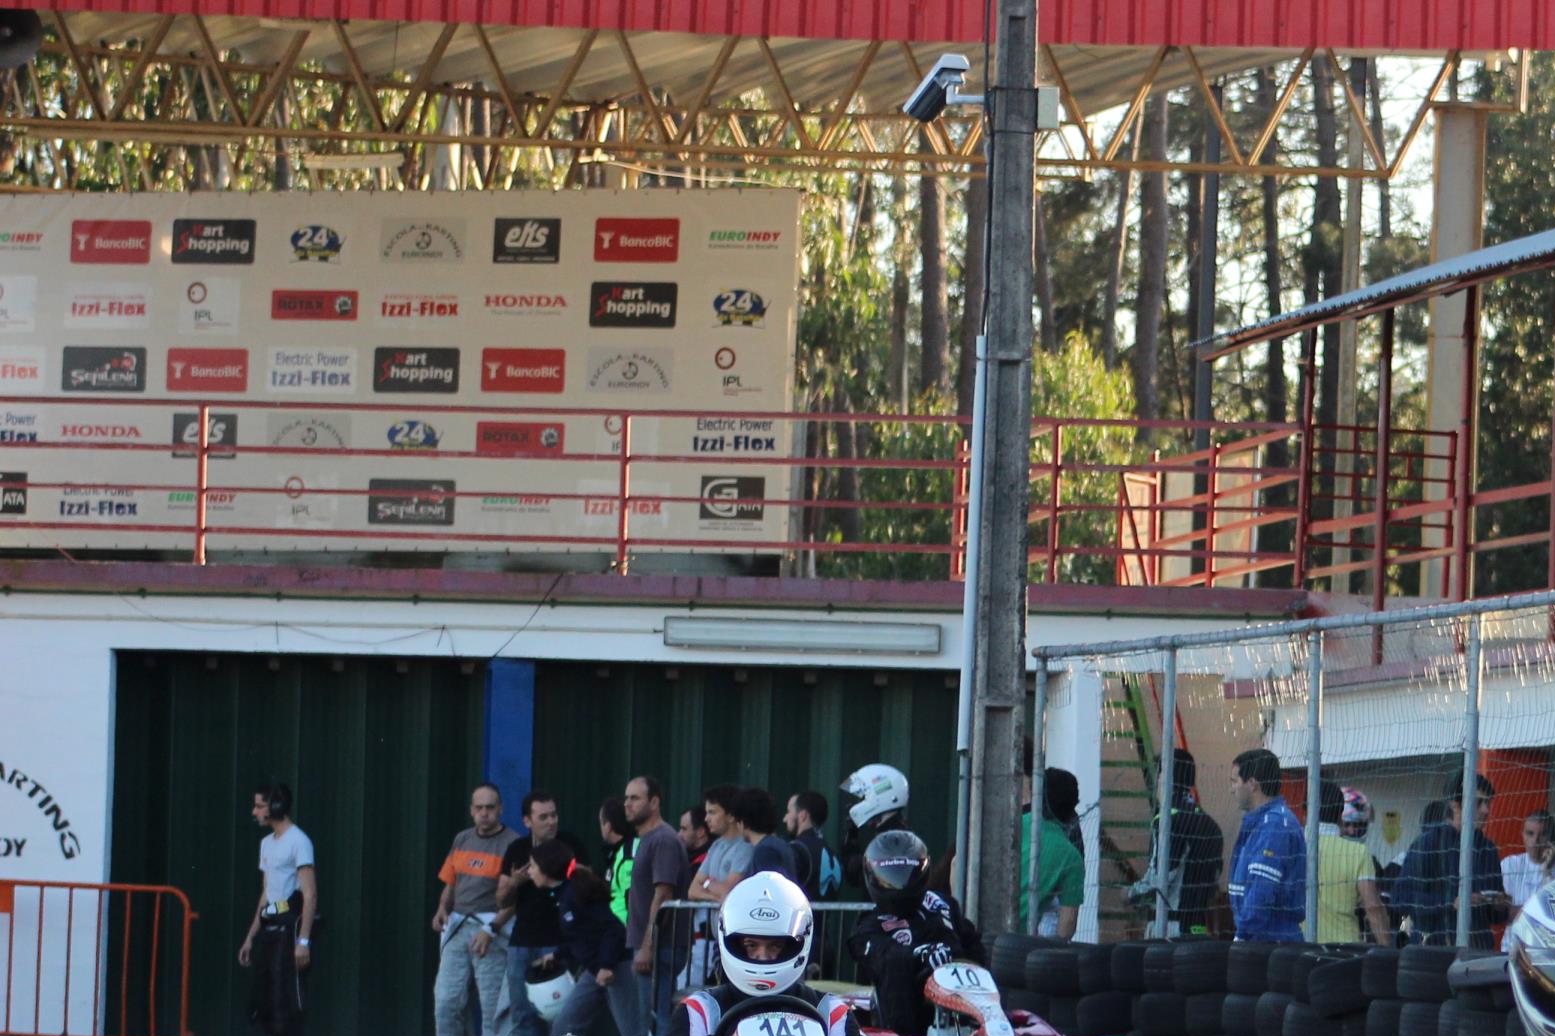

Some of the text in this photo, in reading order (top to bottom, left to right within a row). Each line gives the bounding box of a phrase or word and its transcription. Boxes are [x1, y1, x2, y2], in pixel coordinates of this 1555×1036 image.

[95, 236, 145, 249] BancoBIC
[177, 231, 250, 254] Shopping
[619, 235, 675, 248] BancoBIC
[709, 230, 781, 242] EUROINDY
[484, 294, 568, 308] HONDA
[611, 287, 644, 300] Kart
[71, 301, 146, 317] Izzi-Flex
[381, 301, 459, 317] Izzi-Flex
[595, 294, 672, 318] Shopping
[275, 351, 350, 366] Electric Power
[191, 365, 243, 379] BancoBIC
[379, 358, 454, 383] Shopping
[506, 364, 560, 379] BancoBIC
[271, 370, 351, 387] Izzi-Flex
[6, 412, 36, 426] Power
[696, 417, 774, 431] Electric Power
[60, 424, 142, 438] HONDA
[692, 435, 776, 452] Izzi-Flex
[59, 500, 138, 516] Izzi-Flex
[752, 907, 779, 920] Arai
[951, 967, 981, 987] 10
